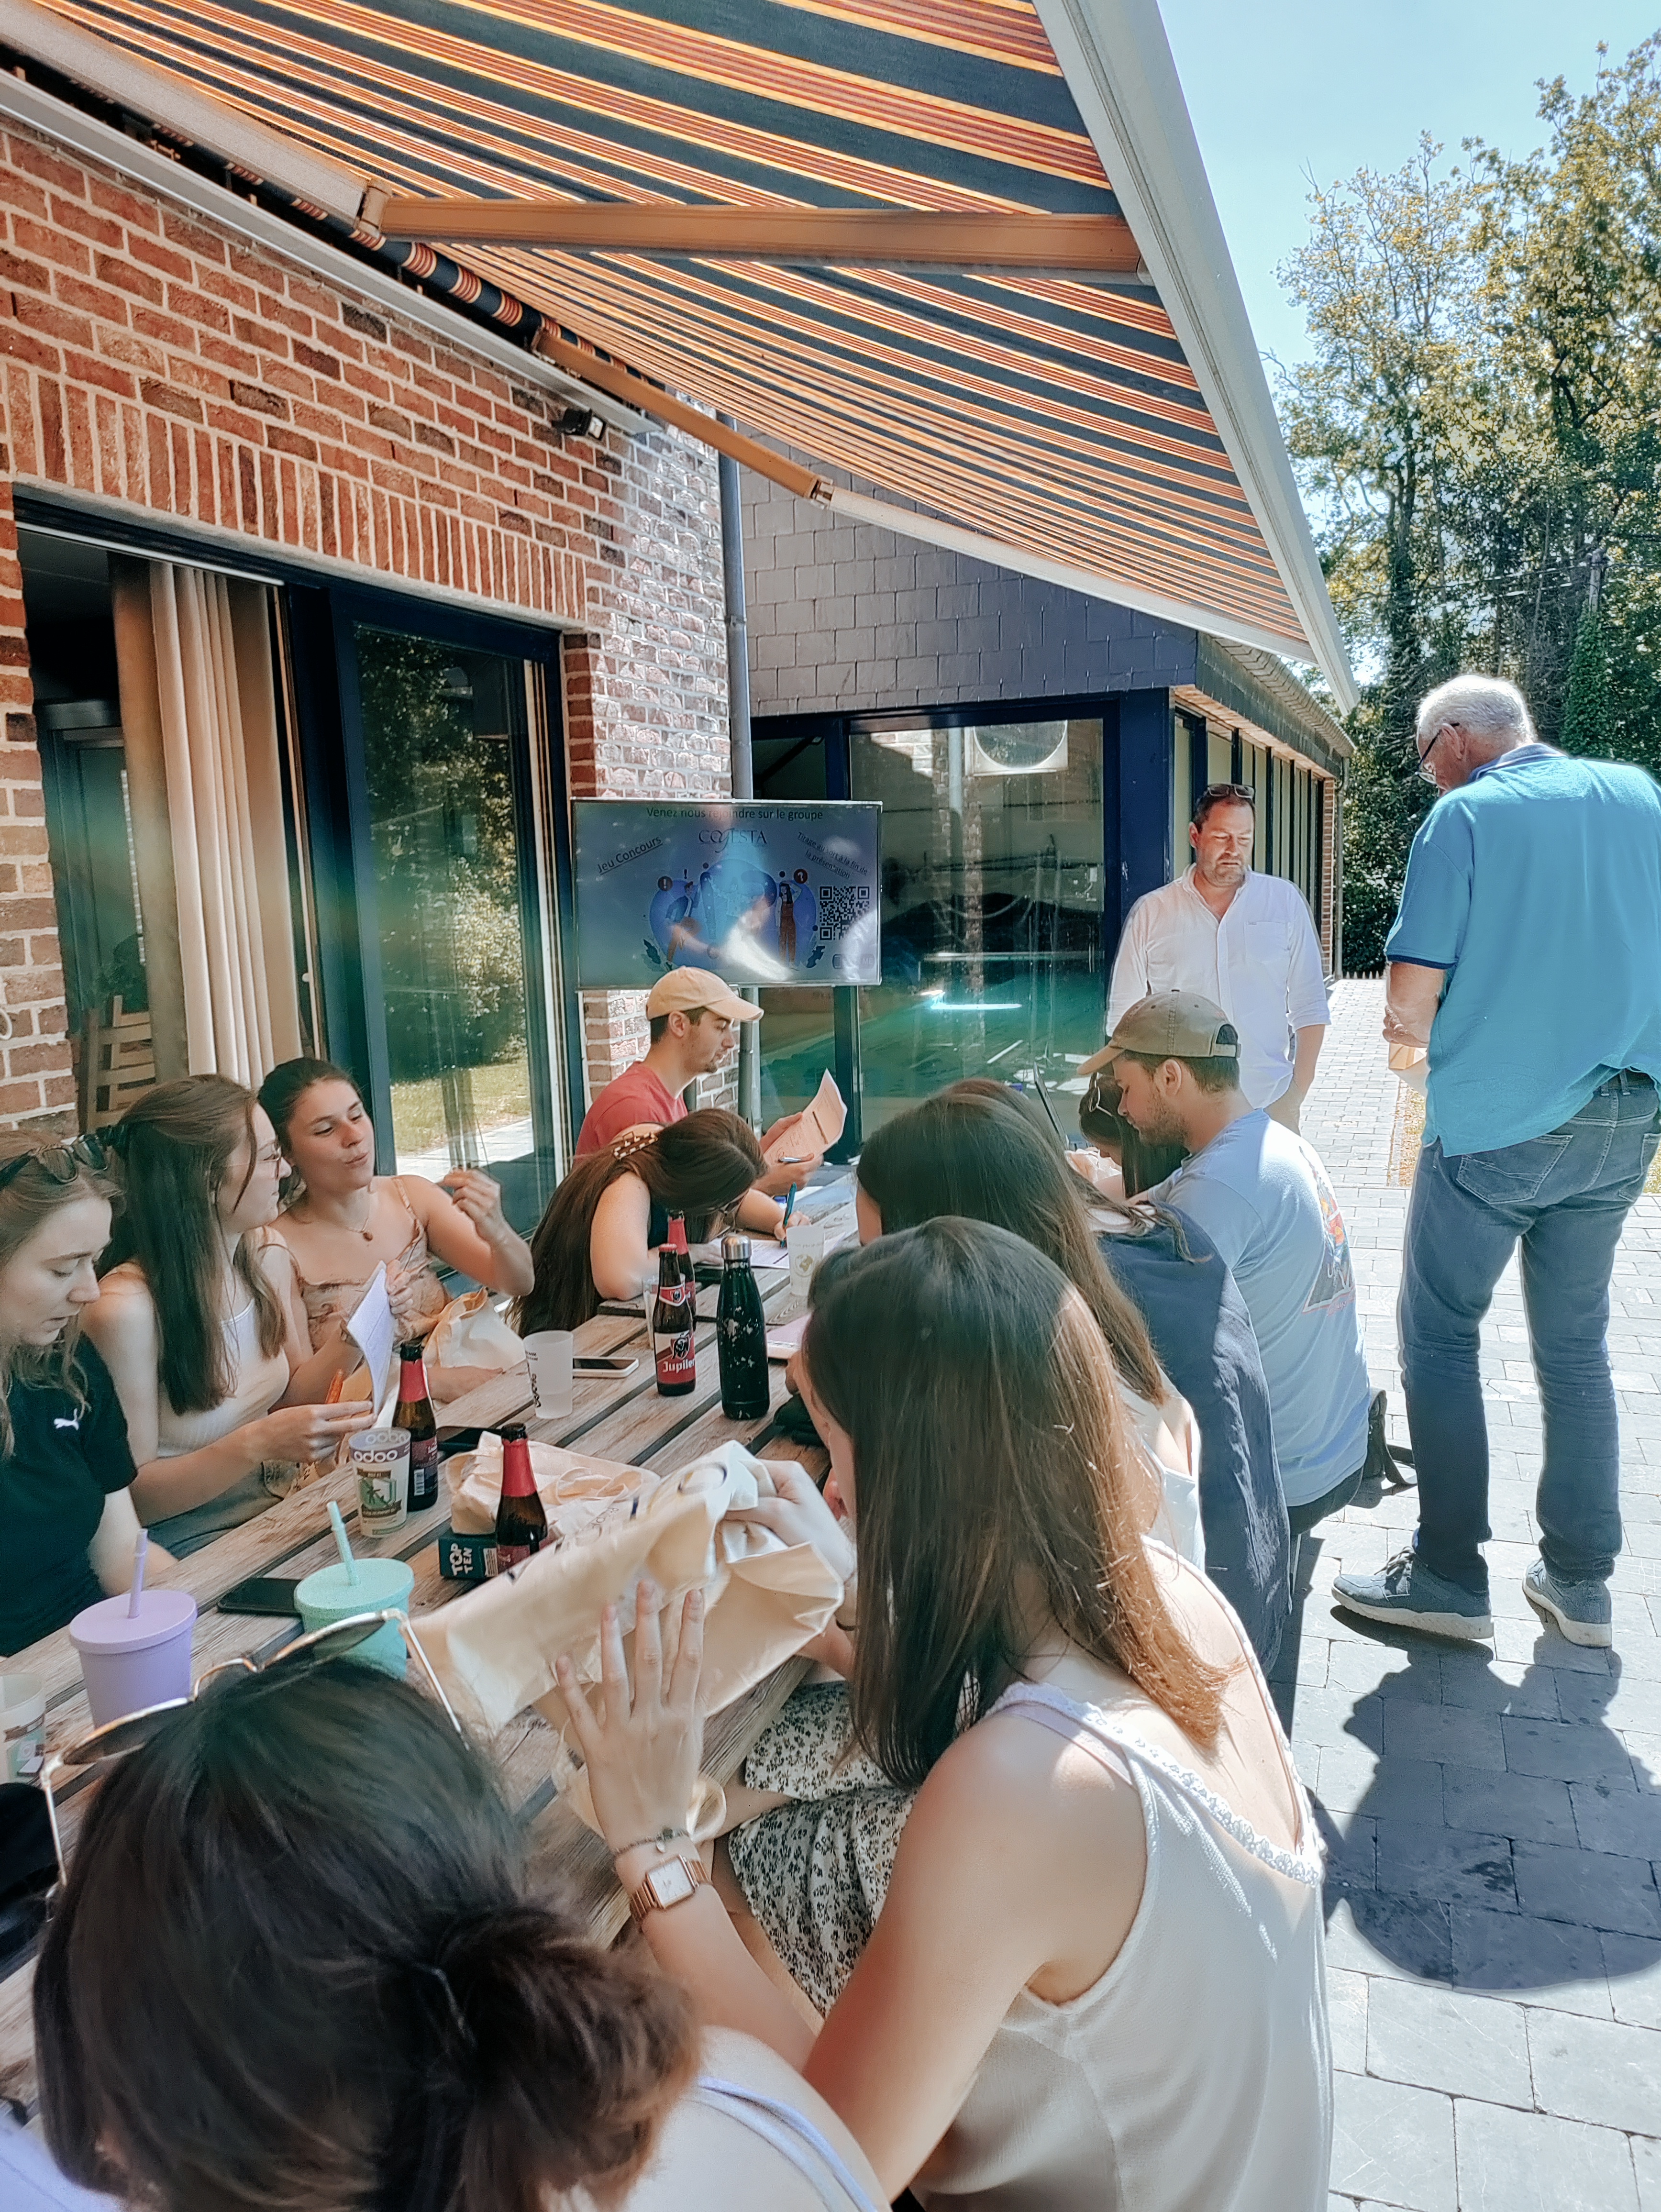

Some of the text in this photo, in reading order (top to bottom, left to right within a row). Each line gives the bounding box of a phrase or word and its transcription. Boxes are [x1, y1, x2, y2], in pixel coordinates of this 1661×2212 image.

[646, 807, 823, 822] Venez nous rejoindre sur le groupe
[598, 837, 662, 874] Jeu Concours
[797, 832, 817, 846] Tirage
[825, 849, 838, 859] sort
[843, 856, 850, 865] la
[851, 861, 859, 870] fin
[860, 866, 868, 874] de
[811, 855, 850, 879] présentation
[663, 1358, 695, 1374] Jupiler
[354, 1449, 398, 1463] odoo
[449, 1543, 463, 1576] TOP
[463, 1547, 473, 1574] TEN
